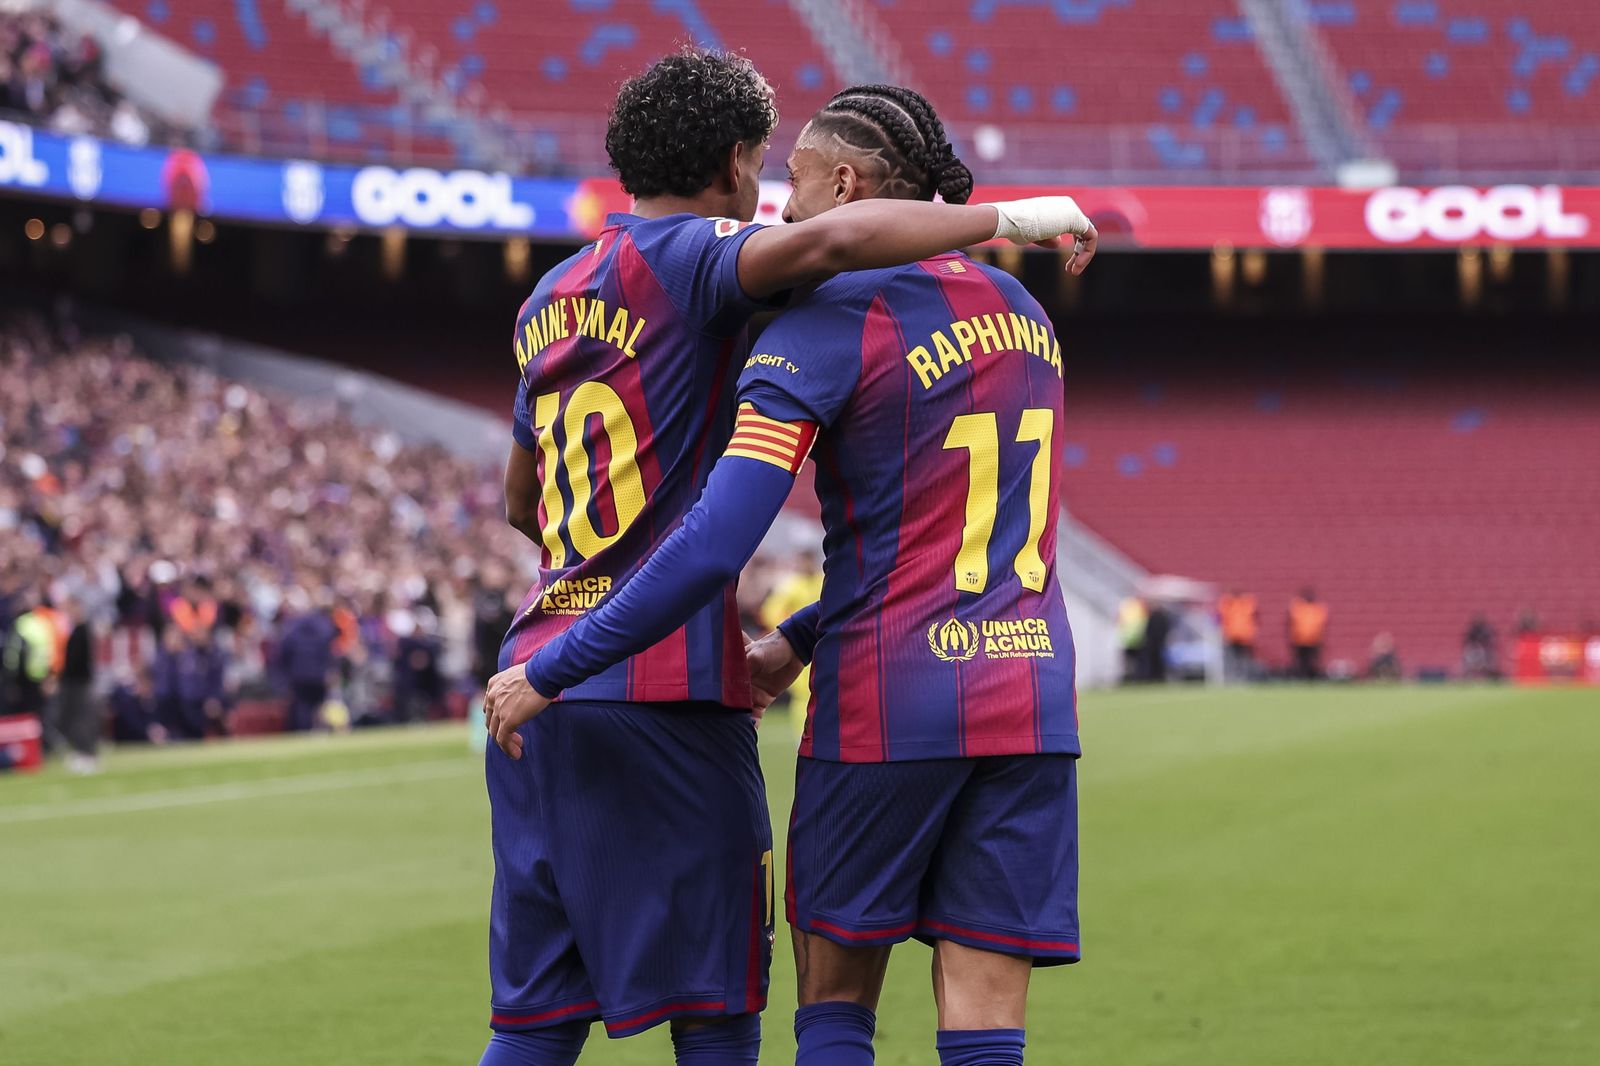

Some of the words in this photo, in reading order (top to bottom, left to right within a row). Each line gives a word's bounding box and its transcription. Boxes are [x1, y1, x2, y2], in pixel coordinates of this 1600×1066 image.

[906, 313, 1063, 390] RAPHINHA
[785, 361, 800, 374] tv
[535, 381, 647, 569] 10
[942, 408, 1053, 594] 11
[982, 618, 1049, 637] UNHCR
[984, 635, 1053, 653] ACNUR
[1010, 651, 1035, 659] Refugee
[1035, 650, 1055, 659] Agency
